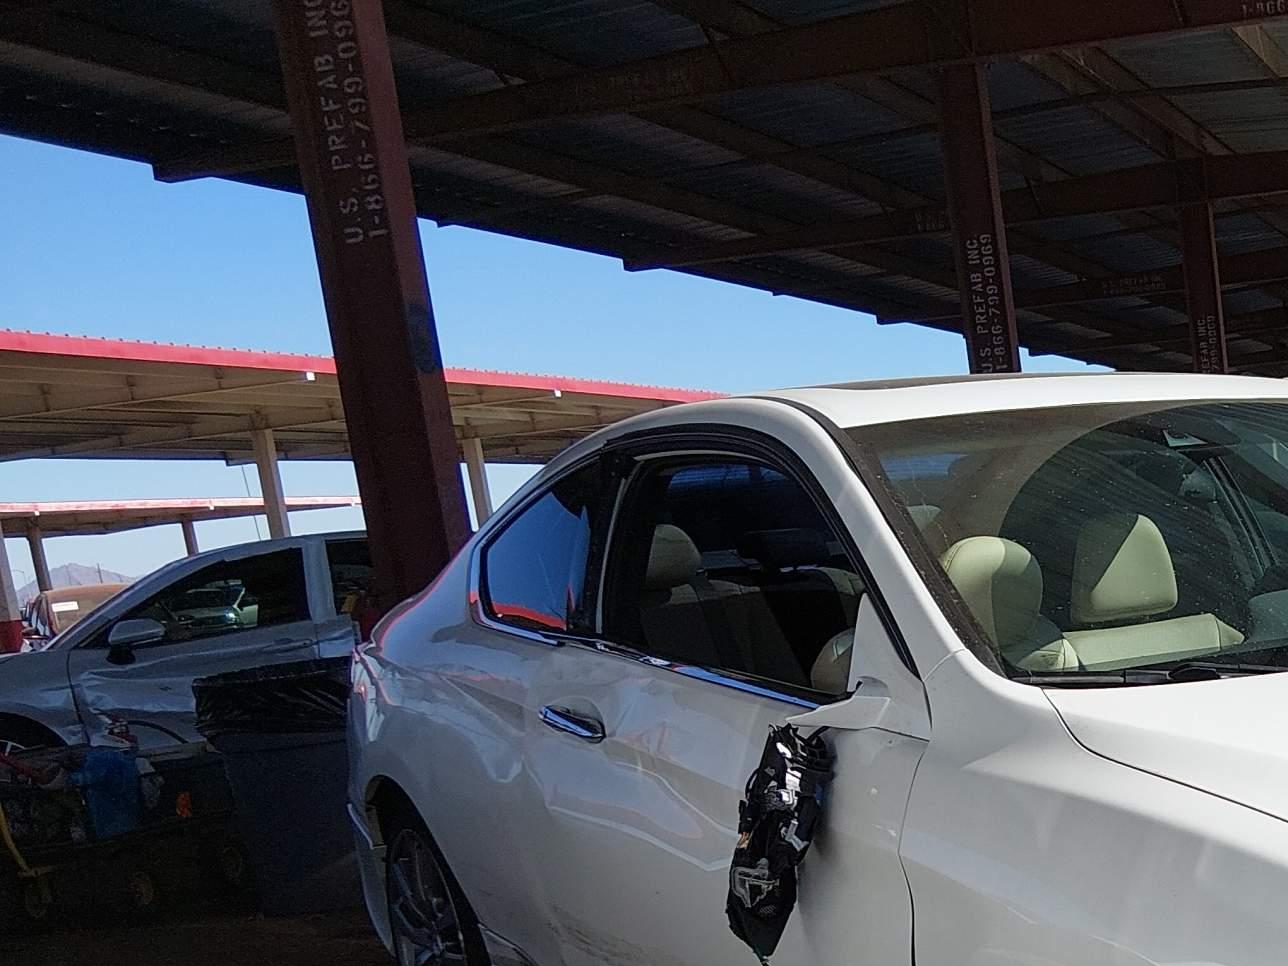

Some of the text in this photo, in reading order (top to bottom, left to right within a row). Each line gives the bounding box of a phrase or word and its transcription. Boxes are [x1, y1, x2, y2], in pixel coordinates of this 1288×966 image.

[314, 54, 352, 171] PREFAB
[340, 187, 365, 244] U.S.
[970, 272, 989, 335] PREFAB
